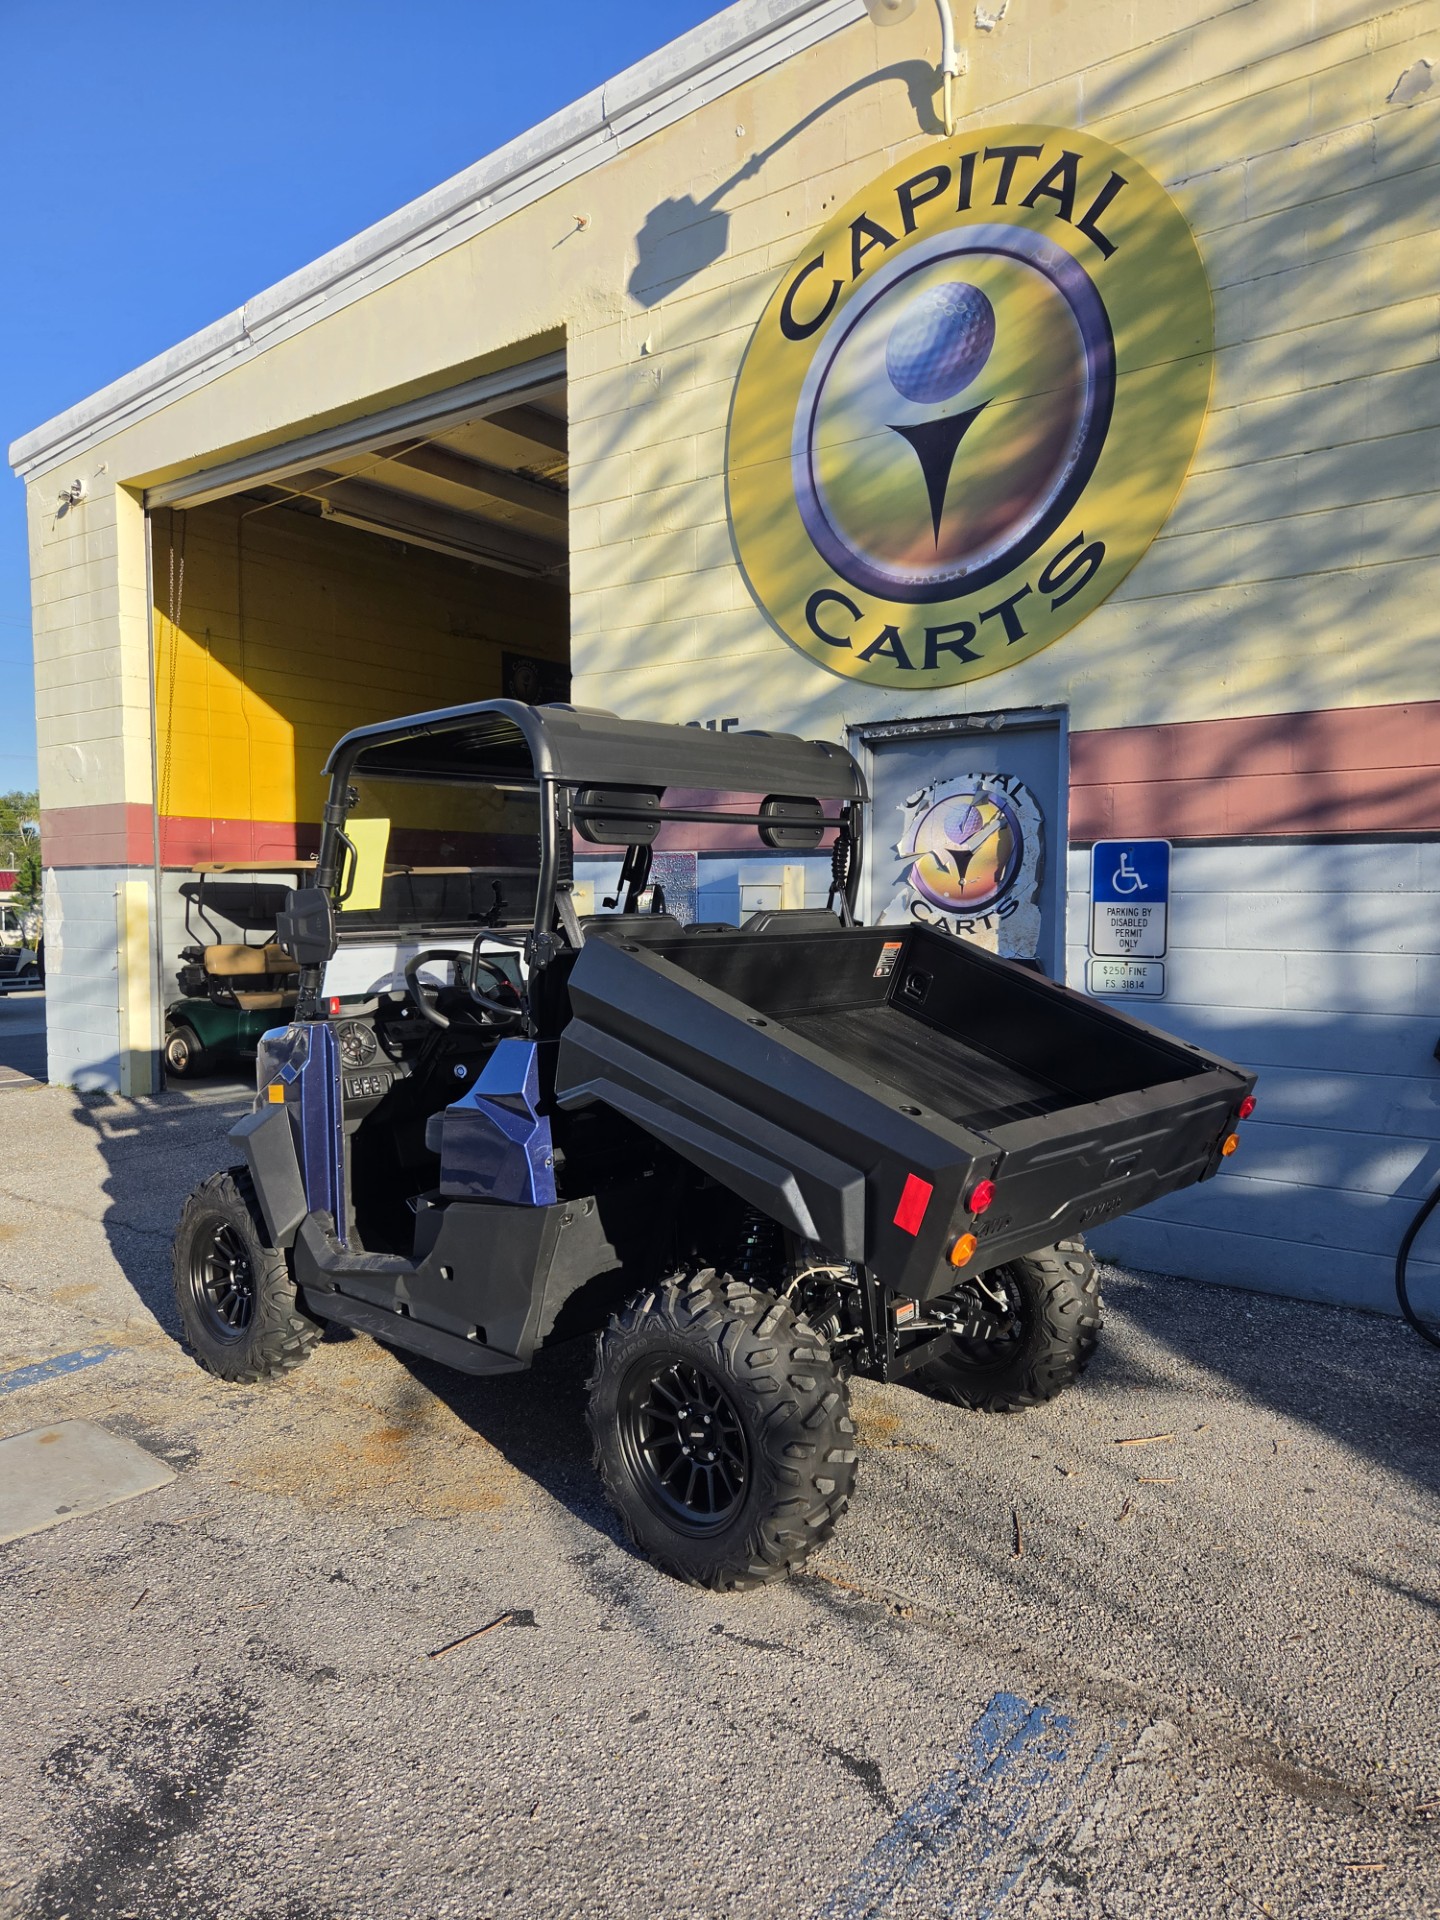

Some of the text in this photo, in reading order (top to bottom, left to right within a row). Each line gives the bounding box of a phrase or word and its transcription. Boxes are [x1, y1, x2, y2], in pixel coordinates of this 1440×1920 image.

[779, 143, 1129, 343] CAPITAL
[804, 530, 1106, 671] CARTS
[910, 896, 1020, 936] CARTS
[1106, 907, 1152, 918] PARKING BY
[1111, 918, 1148, 928] DISABLED
[1115, 928, 1143, 938] PERMIT
[1119, 938, 1138, 948] ONLY
[1103, 966, 1148, 976] $250 FINE
